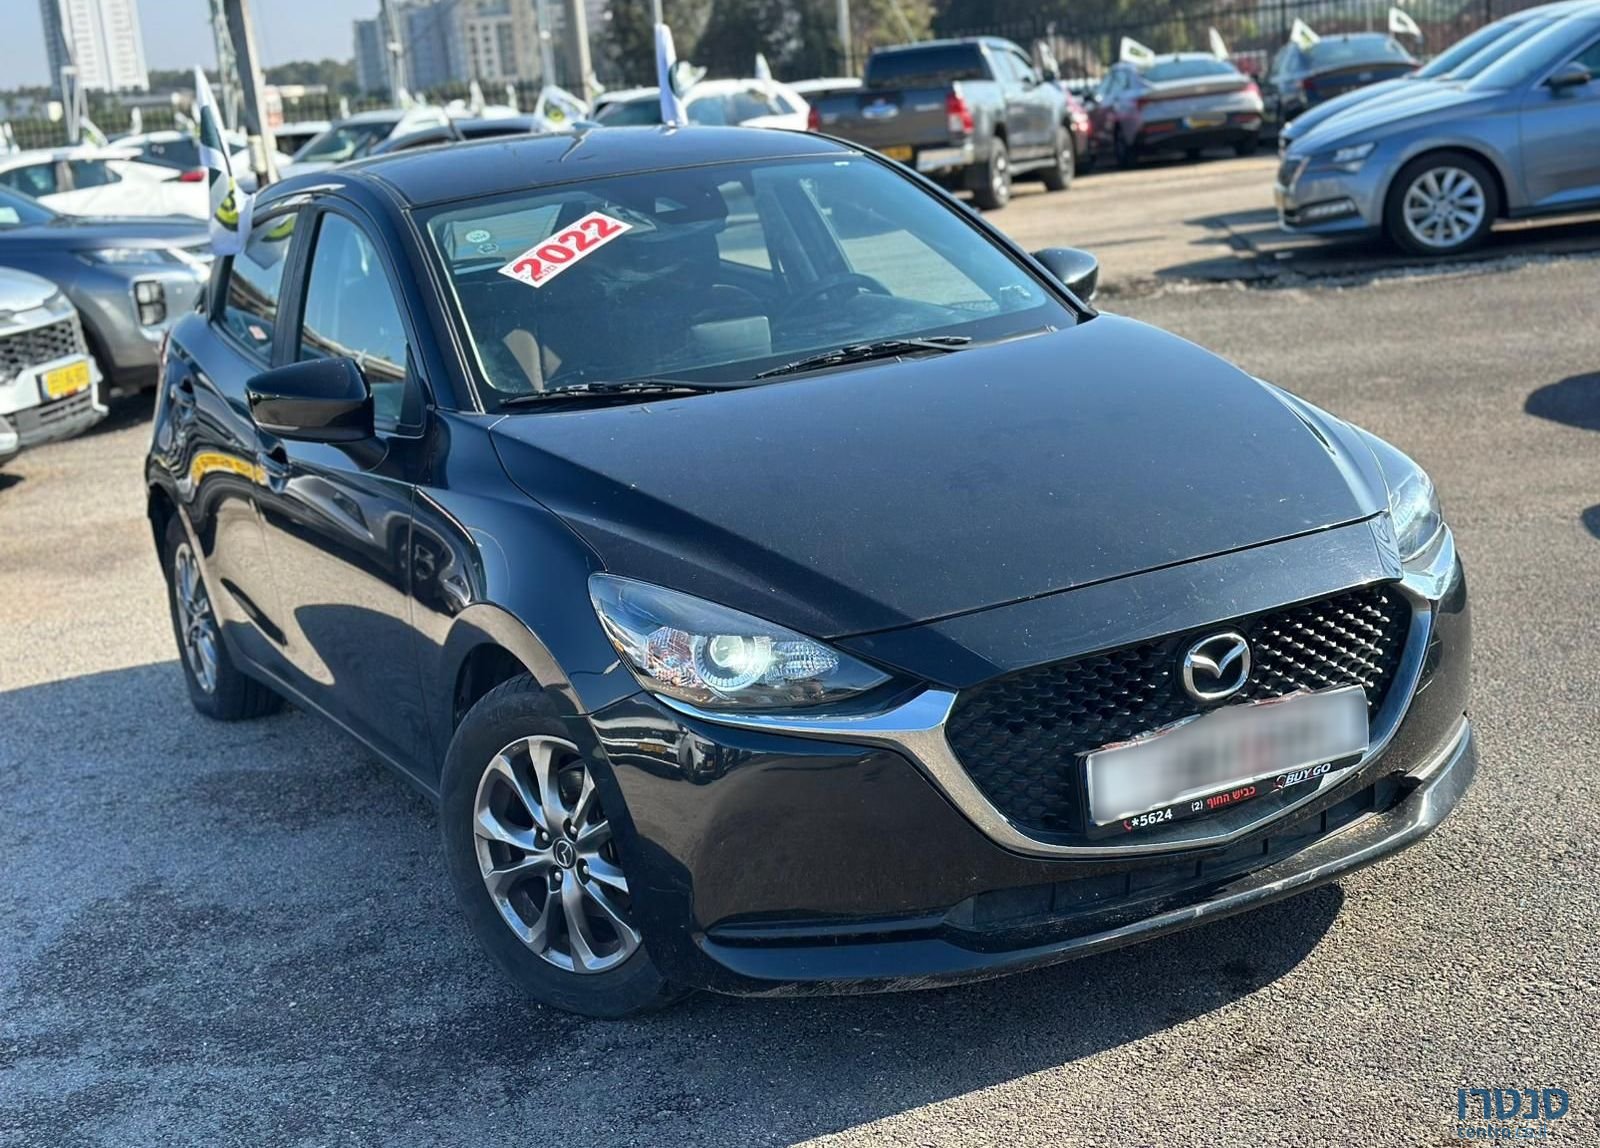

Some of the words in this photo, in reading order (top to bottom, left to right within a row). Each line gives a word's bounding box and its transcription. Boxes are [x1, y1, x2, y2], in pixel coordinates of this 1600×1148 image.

[513, 218, 622, 281] 2022
[1232, 786, 1256, 799] כביש
[1207, 793, 1230, 809] החוף
